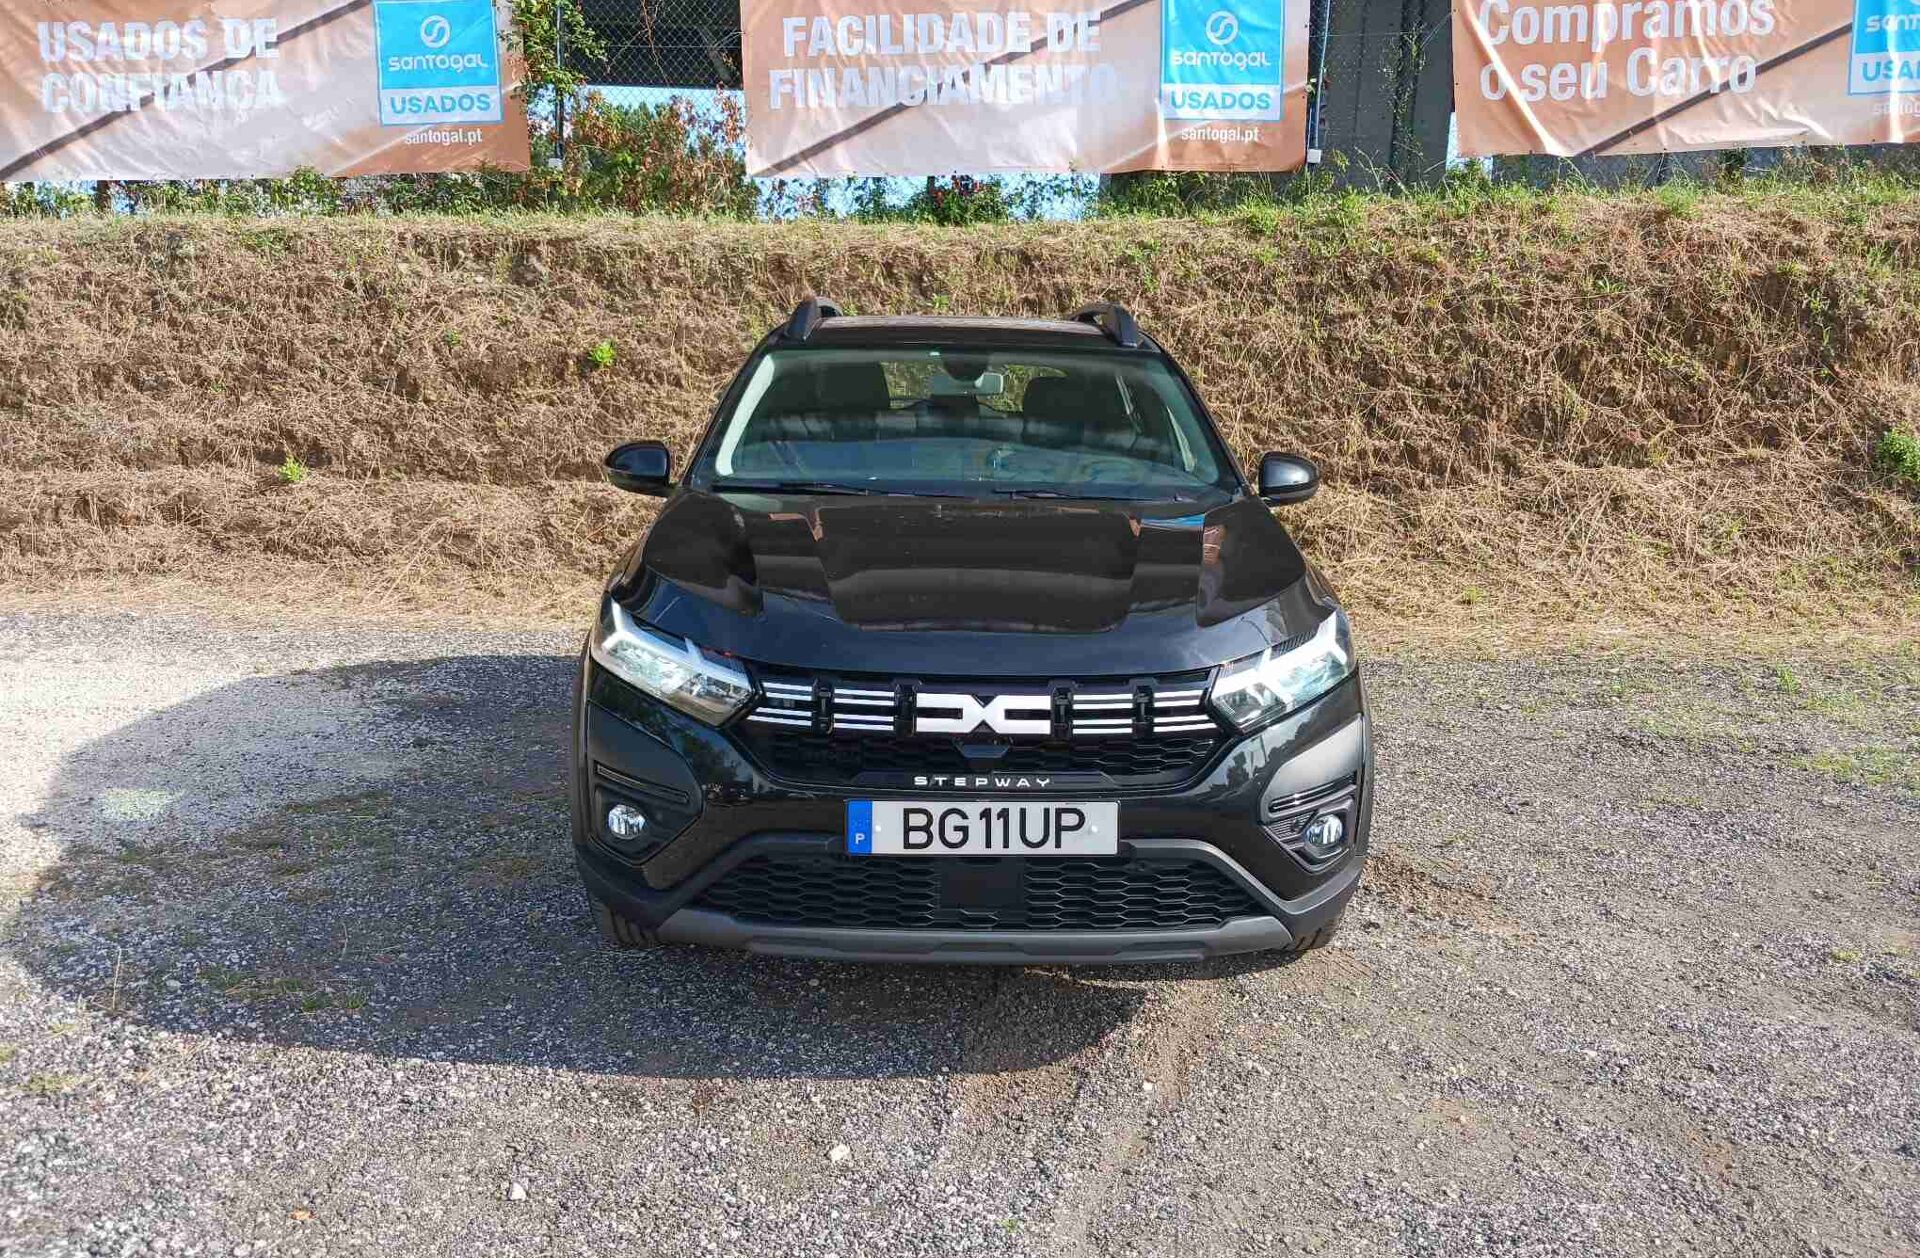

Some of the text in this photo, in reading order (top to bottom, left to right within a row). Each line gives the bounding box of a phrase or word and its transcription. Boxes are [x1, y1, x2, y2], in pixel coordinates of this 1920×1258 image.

[782, 11, 1102, 57] FACILIDADE DE
[1478, 0, 1777, 53] Compramos
[37, 18, 281, 62] USADOS DE
[1480, 46, 1757, 102] o seu Carro
[1862, 59, 1920, 82] USA
[768, 61, 1119, 110] FINANCIAMENTO
[390, 93, 492, 115] USADOS
[1170, 91, 1272, 111] USADOS
[404, 127, 483, 146] santogal.pt
[1181, 126, 1262, 144] santogal.pt
[914, 776, 1051, 788] STEPWAY
[855, 833, 866, 845] P
